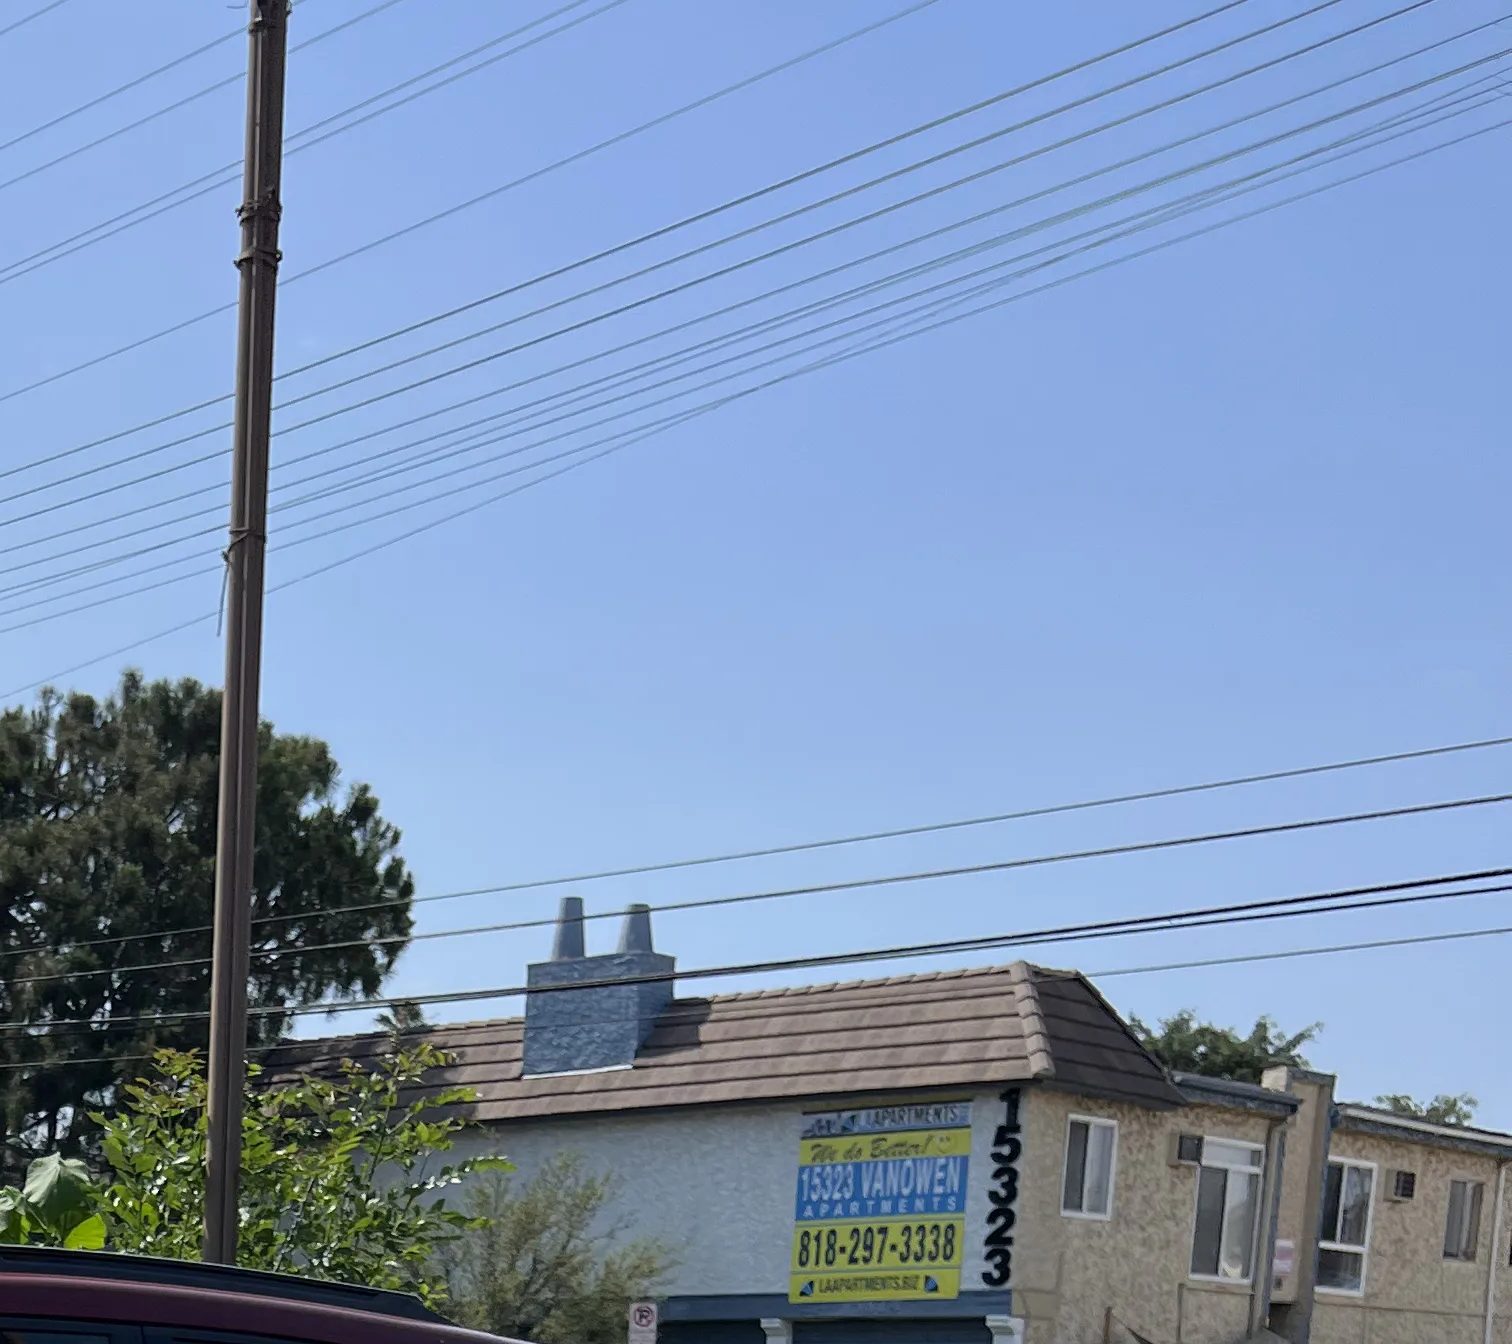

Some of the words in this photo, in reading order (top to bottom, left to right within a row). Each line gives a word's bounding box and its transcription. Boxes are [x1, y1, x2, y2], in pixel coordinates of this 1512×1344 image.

[801, 1163, 854, 1202] 15323
[861, 1156, 961, 1199] VANOWEN
[981, 1087, 1022, 1287] 15323
[802, 1195, 957, 1218] APARTMENTS
[798, 1223, 956, 1268] 818-297-3338
